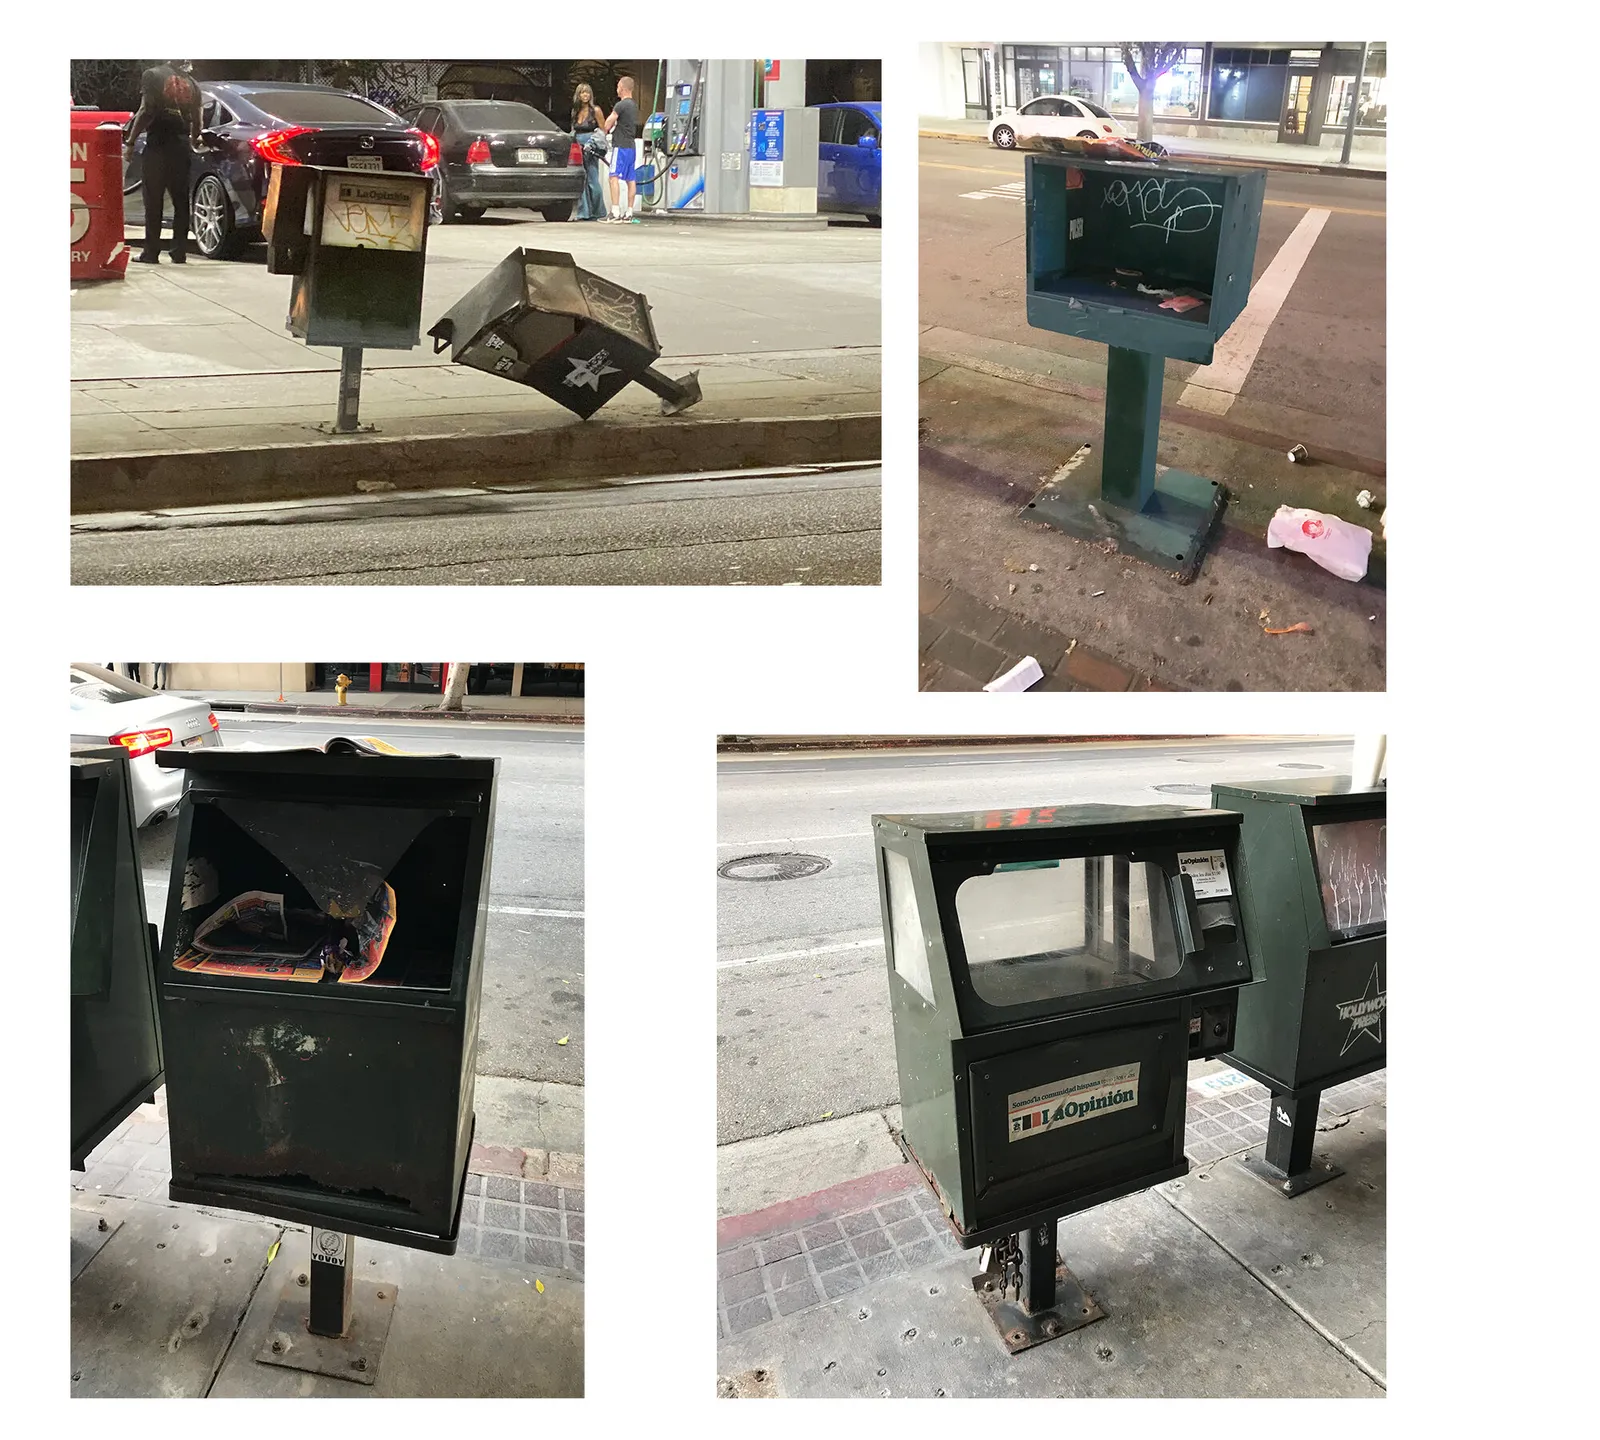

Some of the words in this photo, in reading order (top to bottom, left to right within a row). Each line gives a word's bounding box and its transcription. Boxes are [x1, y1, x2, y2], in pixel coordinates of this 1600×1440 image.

[1041, 1084, 1077, 1101] comunidad
[1077, 1080, 1100, 1092] hispana
[1042, 1089, 1134, 1125] LaOpinión
[312, 1252, 344, 1265] YOVOY
